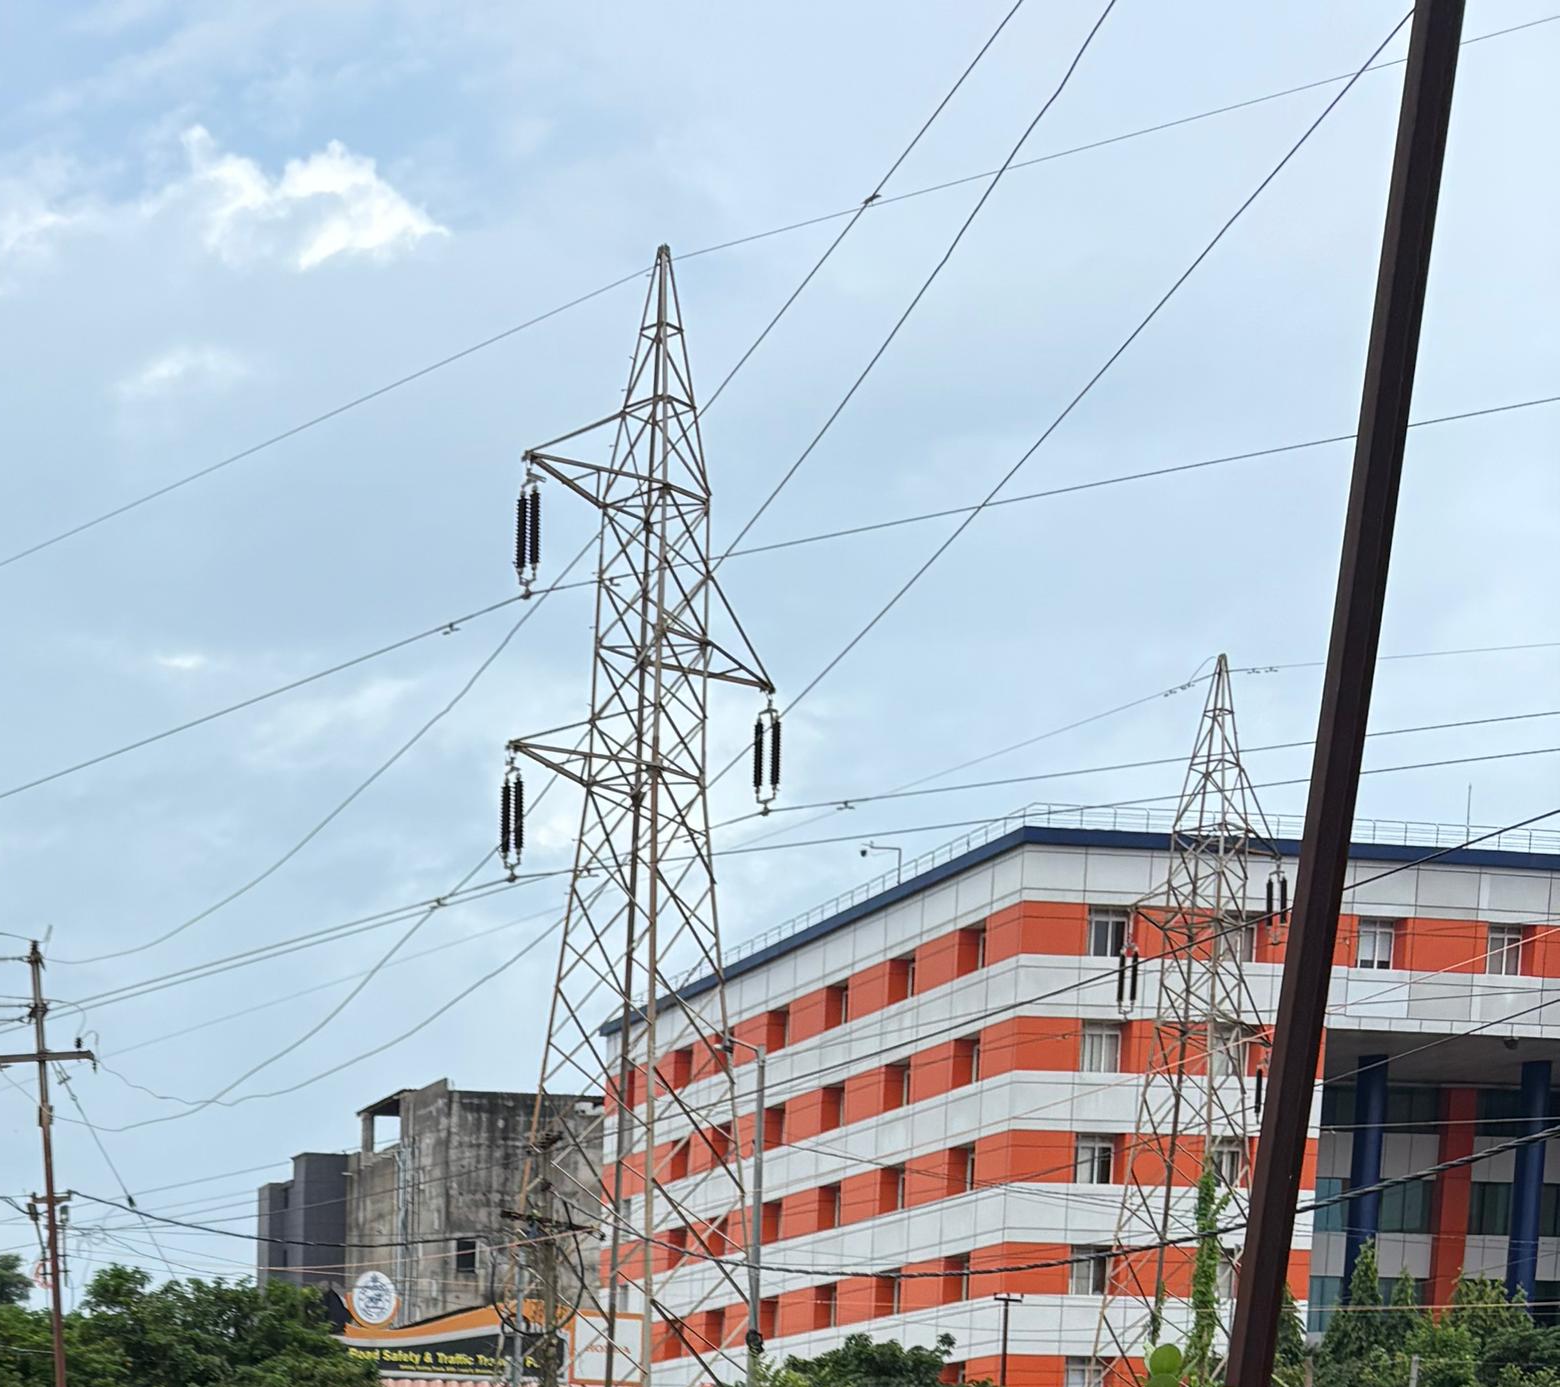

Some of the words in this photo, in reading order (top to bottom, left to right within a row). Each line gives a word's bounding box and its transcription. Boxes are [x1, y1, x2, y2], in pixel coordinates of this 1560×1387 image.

[382, 1349, 421, 1364] Safety
[423, 1351, 433, 1363] &
[436, 1352, 474, 1365] Traffic
